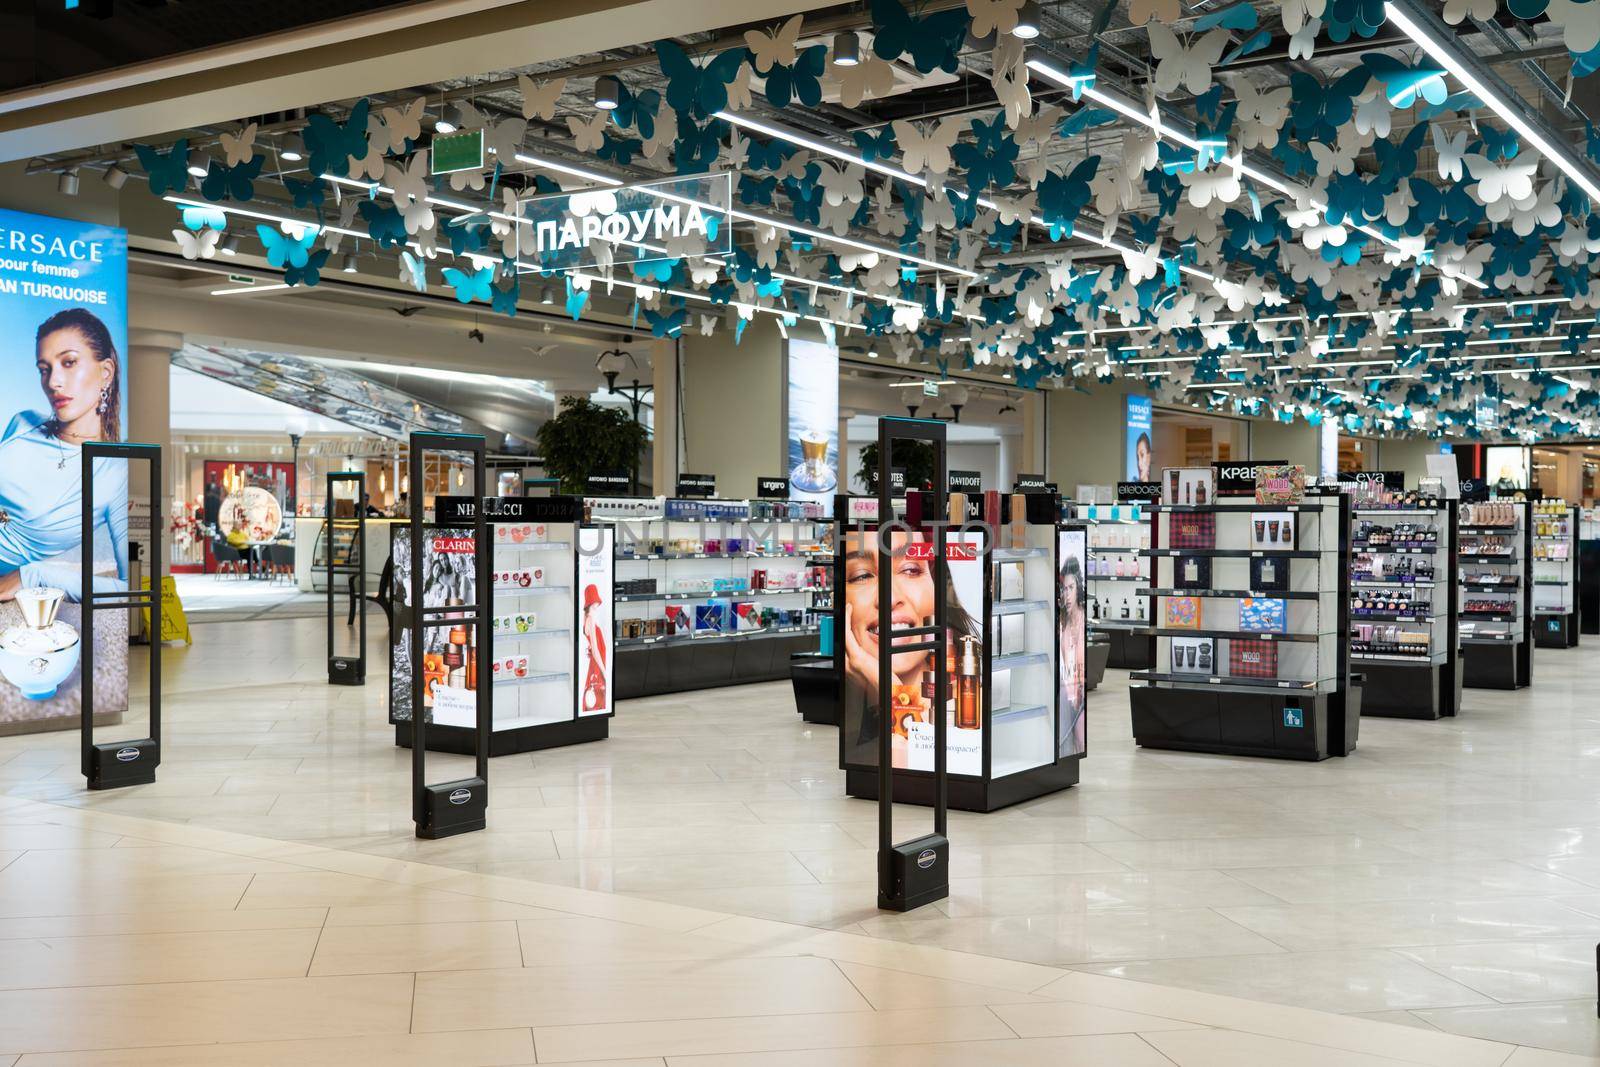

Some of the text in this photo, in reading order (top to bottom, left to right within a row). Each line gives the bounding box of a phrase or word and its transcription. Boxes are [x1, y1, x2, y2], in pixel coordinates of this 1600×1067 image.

[537, 204, 708, 252] ПАРФУМА
[31, 260, 80, 278] femme
[21, 281, 107, 304] TURQUOISE
[763, 481, 785, 491] ungaro
[950, 477, 981, 487] DAVIDOFF
[1267, 479, 1289, 489] WOOD
[1459, 479, 1473, 491] té
[1181, 524, 1200, 534] WOOD
[433, 539, 476, 551] CLARIN
[905, 546, 978, 558] CLAINS
[1242, 652, 1261, 660] WOOD
